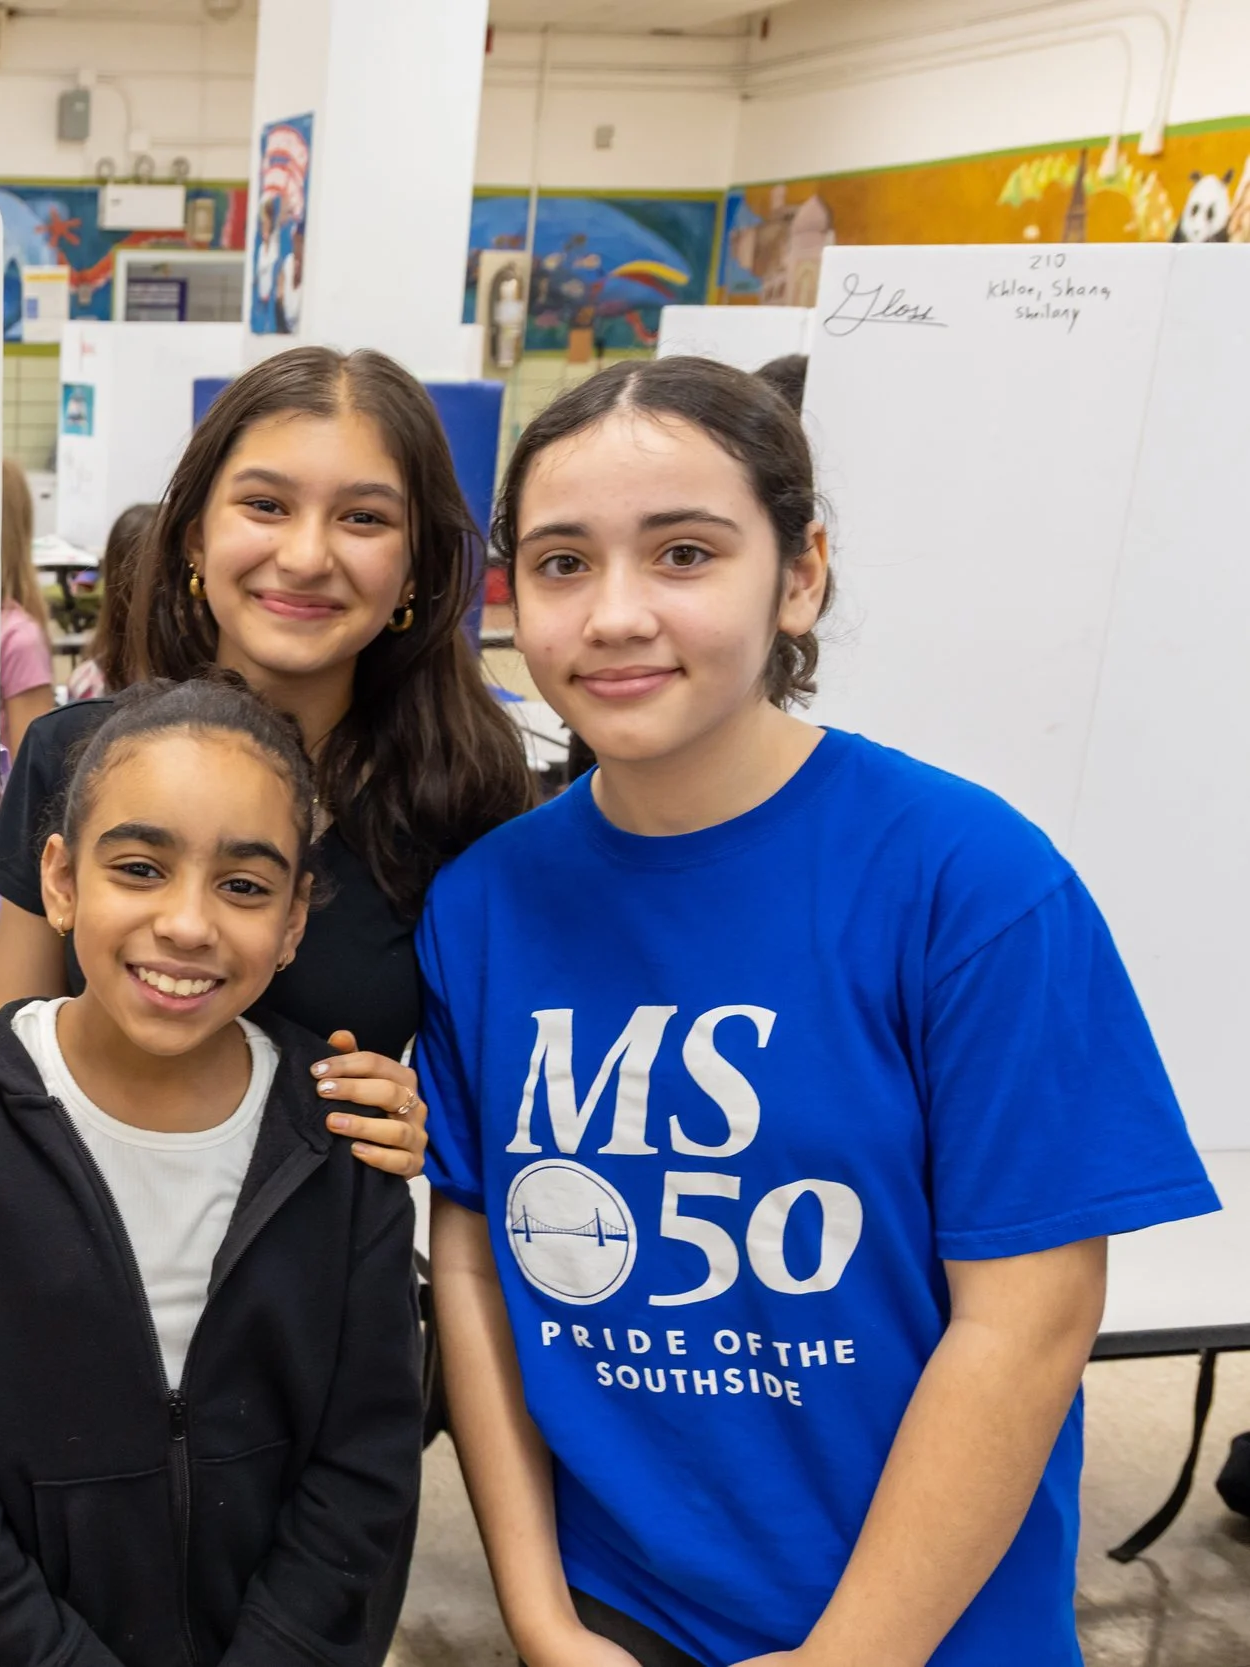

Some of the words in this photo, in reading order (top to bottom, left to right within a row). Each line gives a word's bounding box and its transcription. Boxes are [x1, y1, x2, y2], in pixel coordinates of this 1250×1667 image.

[1028, 252, 1067, 271] 210
[505, 1004, 778, 1158] MS
[648, 1170, 864, 1307] 50
[540, 1320, 688, 1356] PRIDE
[713, 1328, 764, 1357] OF
[771, 1338, 857, 1369] THE
[596, 1361, 804, 1408] SOUTHSIDE
